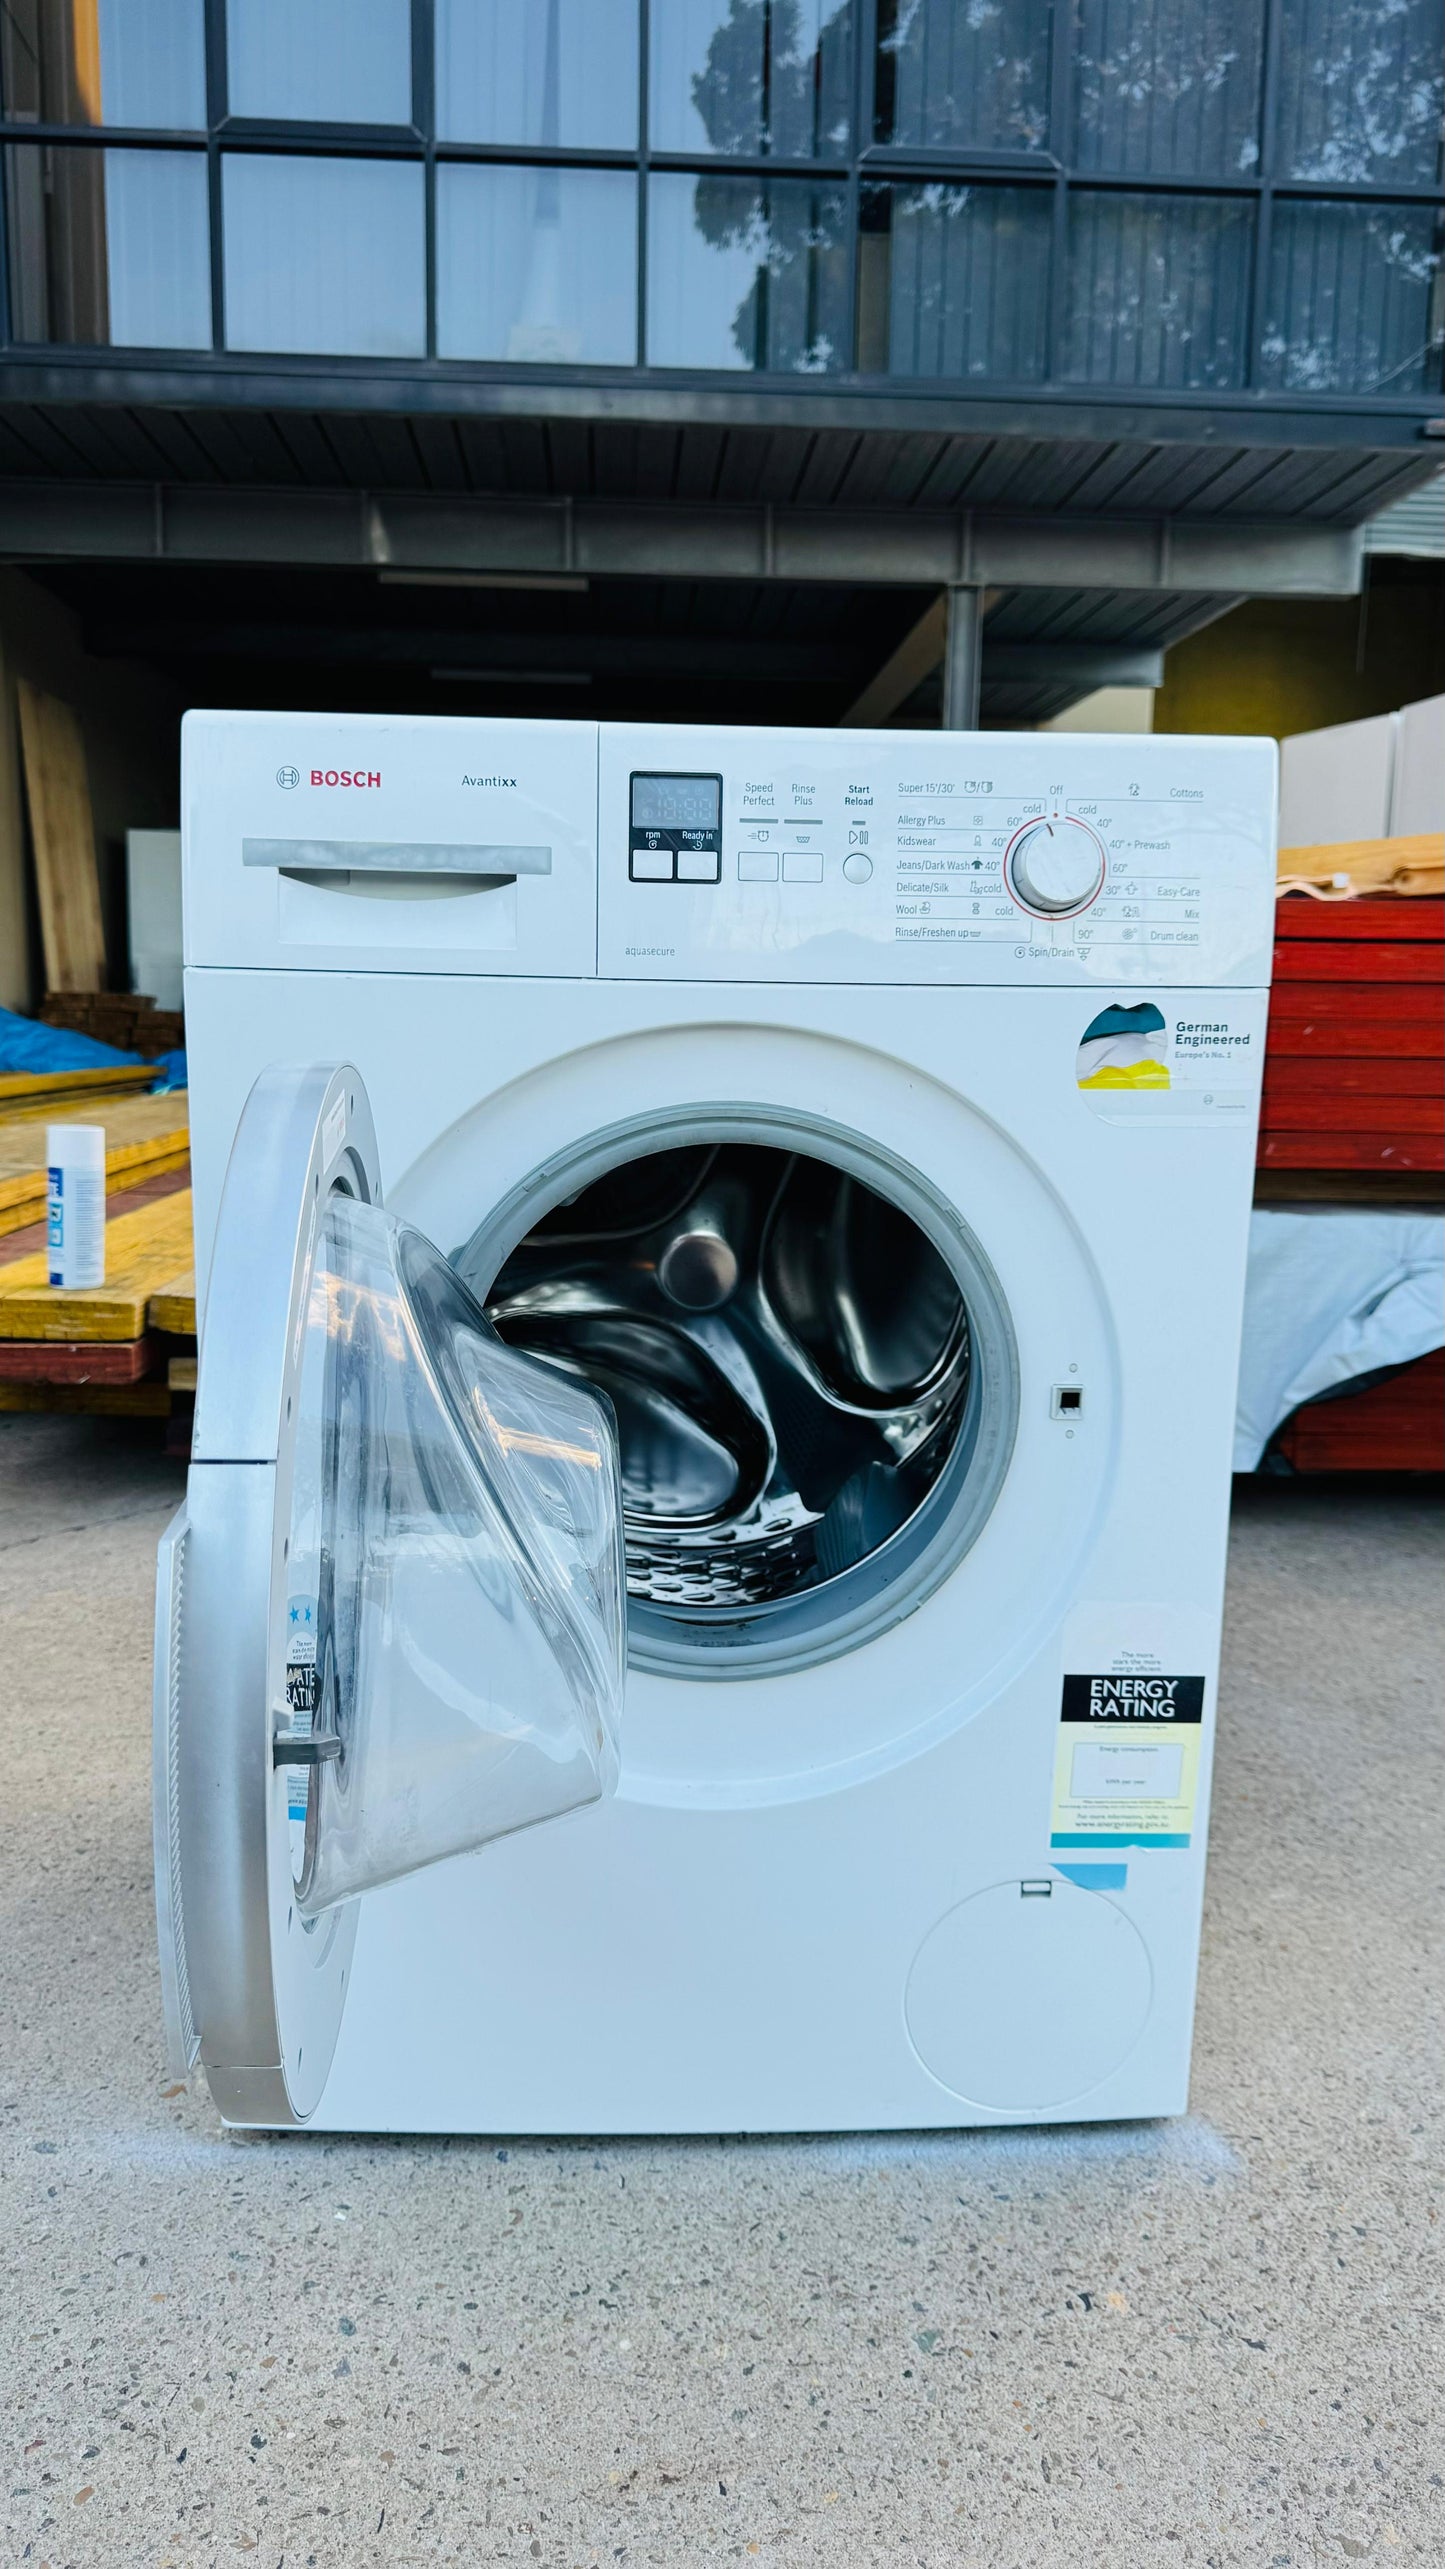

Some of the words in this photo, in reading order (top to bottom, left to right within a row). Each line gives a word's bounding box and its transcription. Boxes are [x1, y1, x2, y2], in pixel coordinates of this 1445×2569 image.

[310, 770, 381, 788] BOSCH
[461, 774, 516, 788] Avantixx
[745, 782, 773, 794] Speed
[792, 784, 816, 794] Rinse
[848, 785, 870, 794] Start
[898, 783, 923, 793] Super
[1050, 785, 1063, 795] Off
[1170, 788, 1204, 798] Cottons
[744, 796, 774, 806] Perfect
[794, 796, 812, 806] Plus
[844, 796, 873, 806] Reload
[1023, 804, 1042, 814] cold
[1078, 805, 1096, 815] cold
[898, 816, 926, 826] Allergy
[928, 816, 946, 825] Plus
[1007, 817, 1022, 826] 60°
[1097, 818, 1112, 828] 40°
[646, 832, 660, 840] rpm
[682, 831, 705, 842] Ready
[706, 832, 712, 840] in
[897, 836, 936, 846] Kidswear
[992, 838, 1007, 847] 40°
[1109, 840, 1124, 850] 40°
[1134, 840, 1170, 850] Prewash
[897, 860, 946, 870] Jeans/Dark
[947, 861, 970, 870] Wash
[984, 861, 1000, 870] 40°
[1112, 863, 1128, 873] 60°
[896, 882, 948, 892] Delicate/Silk
[984, 884, 1002, 893] cold
[1106, 885, 1121, 895] 30°
[1158, 886, 1200, 897] Easy-Care
[896, 905, 917, 914] Wool
[995, 906, 1014, 916] cold
[1185, 909, 1200, 919] Mix
[896, 928, 956, 938] Rinse/Freshen
[958, 930, 969, 938] up
[1078, 930, 1093, 940] 90°
[1151, 931, 1174, 940] Drum
[1176, 932, 1198, 941] clean
[625, 946, 675, 958] aquasecure
[1028, 947, 1074, 958] Spin/Drain
[1176, 1022, 1228, 1032] German
[1176, 1034, 1250, 1047] Engineered
[1090, 1679, 1178, 1698] ENERGY
[1090, 1699, 1176, 1718] RATING
